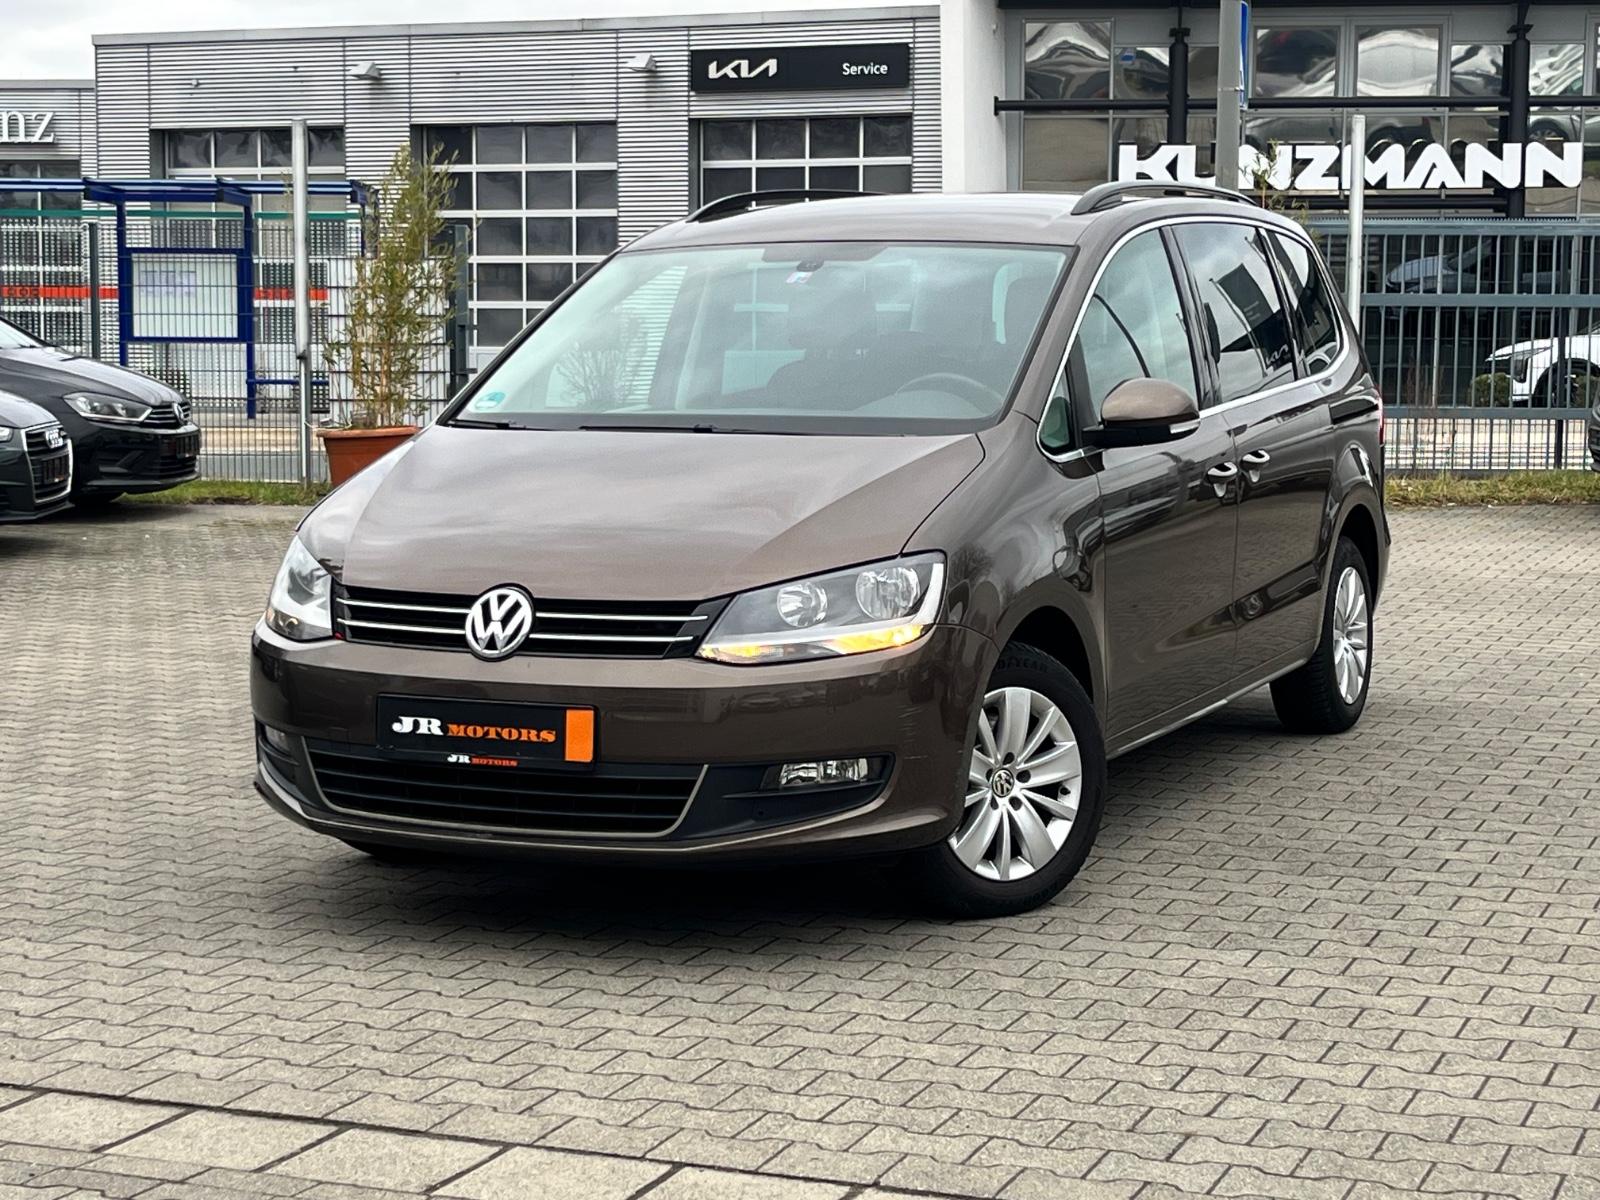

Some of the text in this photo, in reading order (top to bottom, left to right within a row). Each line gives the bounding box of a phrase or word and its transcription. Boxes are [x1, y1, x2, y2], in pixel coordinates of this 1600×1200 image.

[708, 58, 888, 79] KIA Service
[392, 716, 556, 743] JR MOTORS
[447, 754, 518, 767] JR MOTORS
